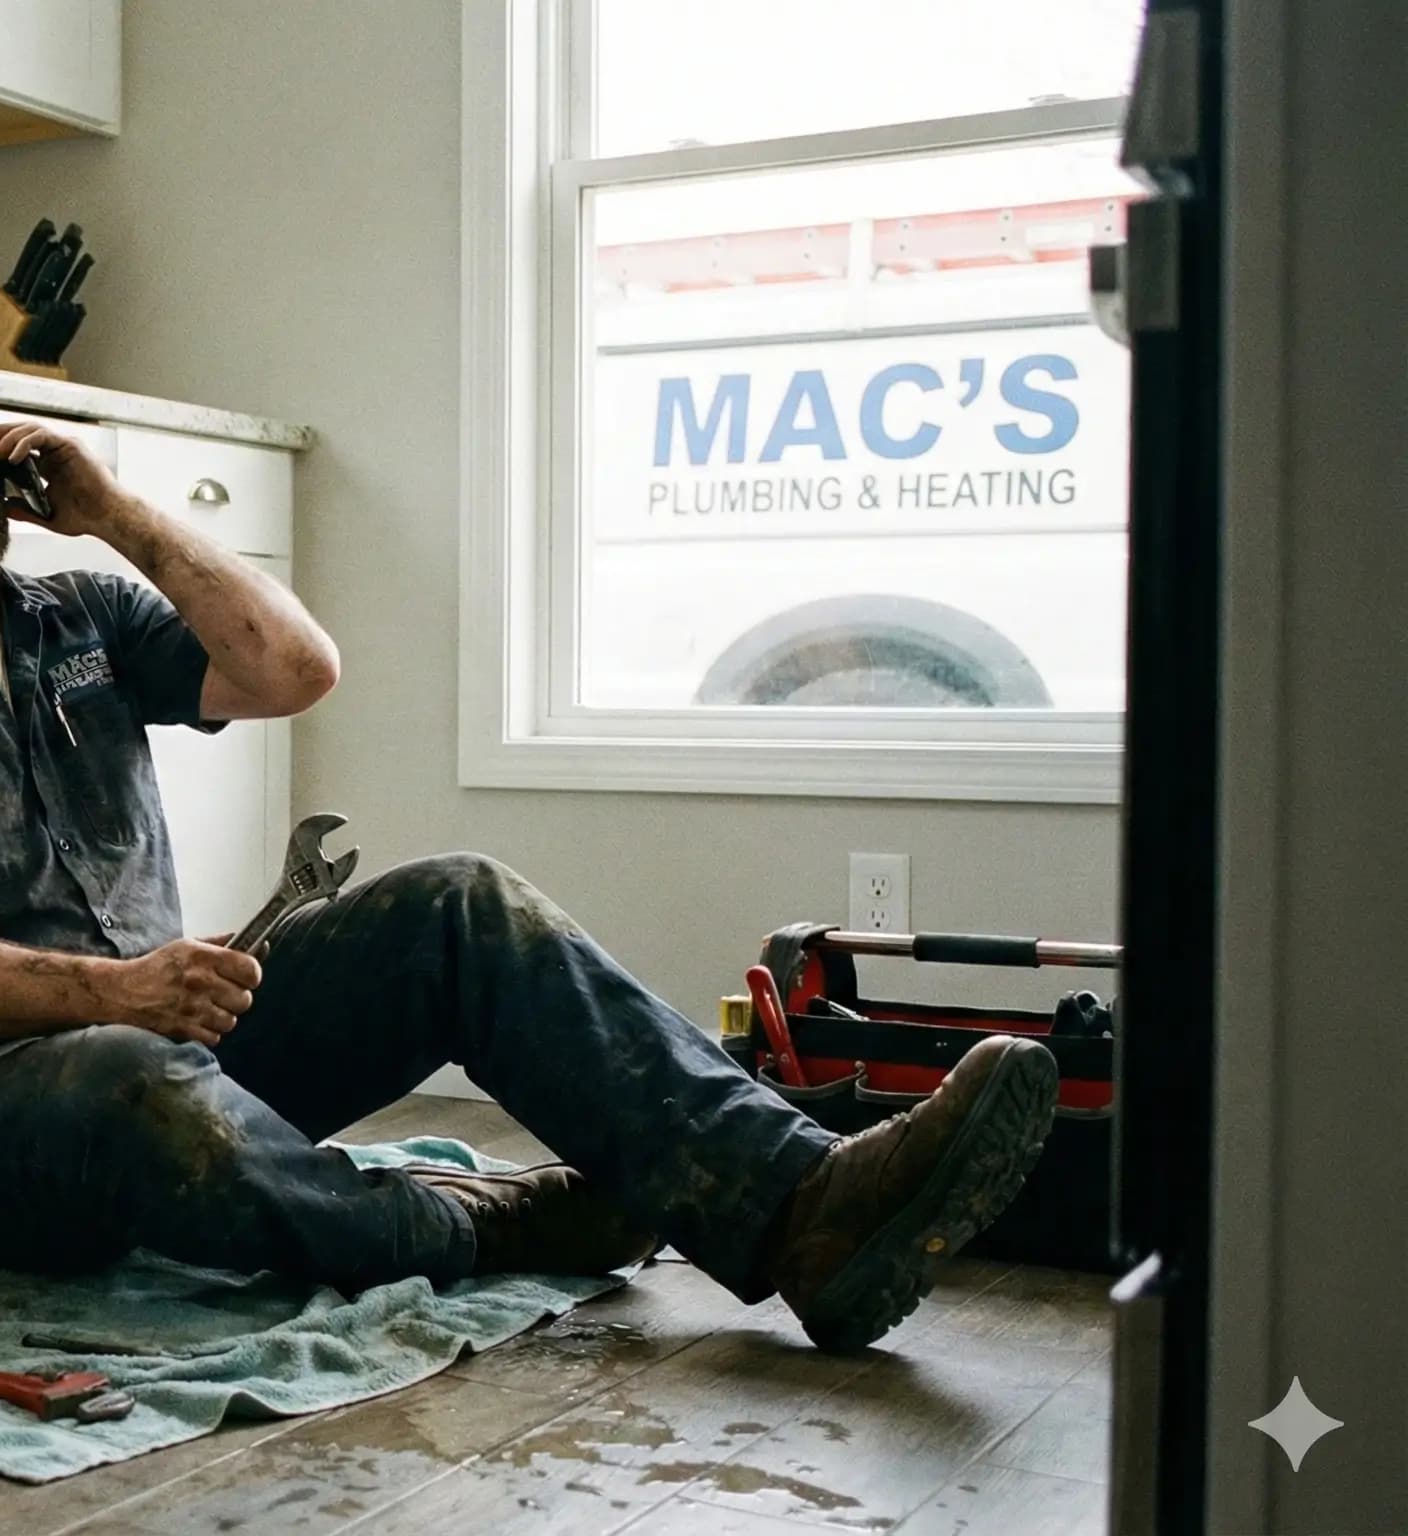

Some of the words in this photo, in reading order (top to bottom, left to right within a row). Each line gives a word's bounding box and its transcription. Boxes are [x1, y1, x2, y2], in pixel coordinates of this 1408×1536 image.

[653, 354, 1080, 466] MAC'S
[649, 477, 842, 515] PLUMBING
[857, 474, 881, 509] &
[898, 468, 1077, 508] HEATING
